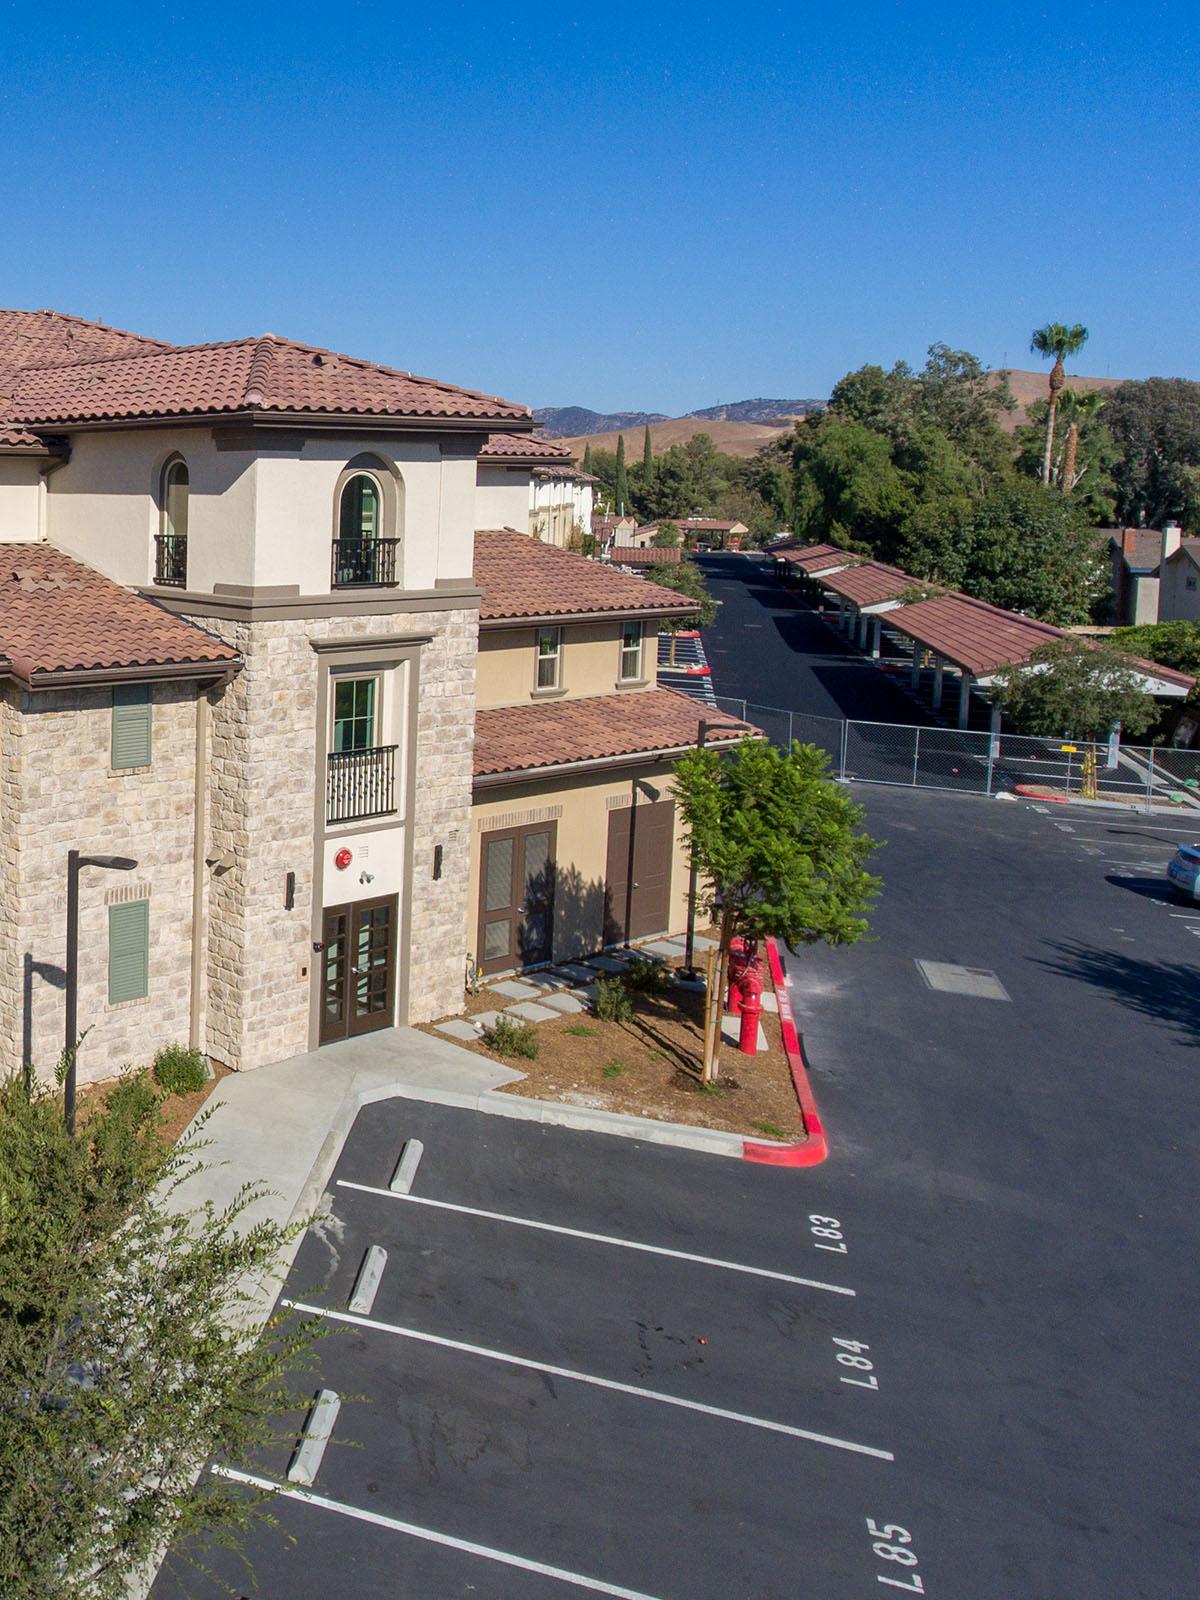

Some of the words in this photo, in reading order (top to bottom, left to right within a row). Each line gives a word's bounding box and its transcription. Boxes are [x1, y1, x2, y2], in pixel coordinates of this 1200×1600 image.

[808, 1214, 849, 1254] L83
[831, 1336, 879, 1391] L84
[866, 1517, 925, 1595] L85
